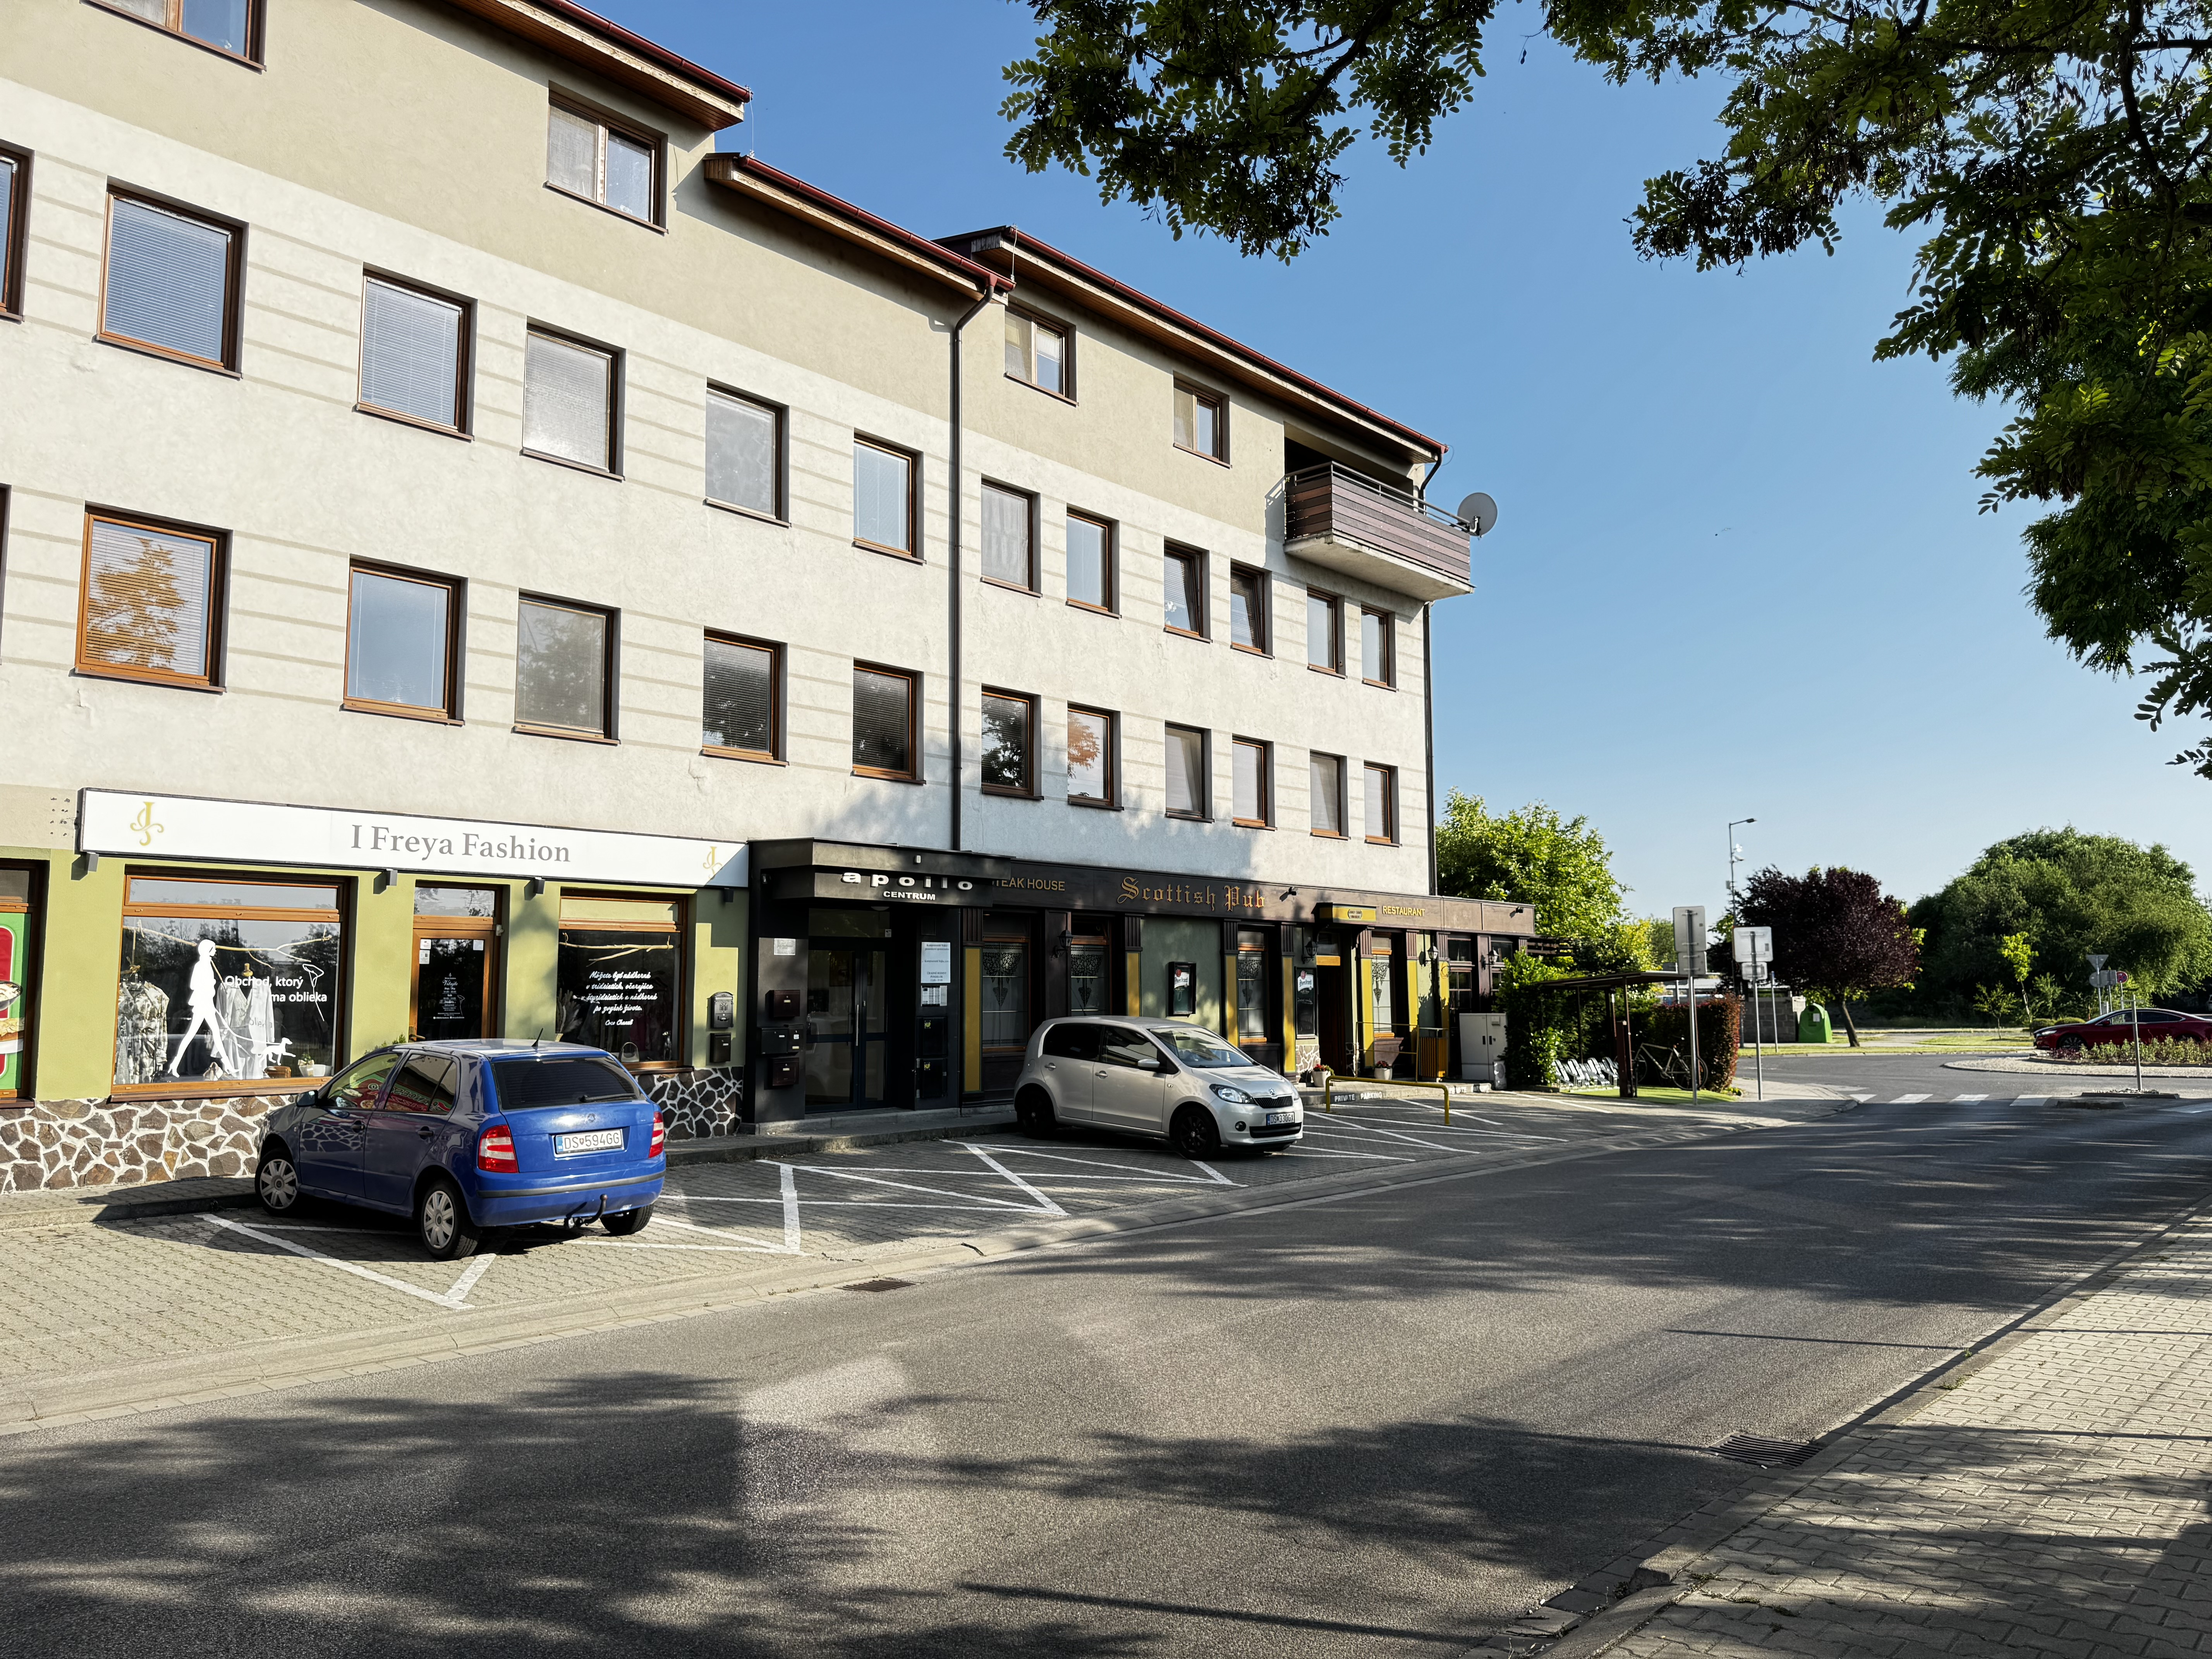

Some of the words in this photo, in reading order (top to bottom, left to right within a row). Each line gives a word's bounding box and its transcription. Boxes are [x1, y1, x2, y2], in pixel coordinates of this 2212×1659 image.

[350, 824, 362, 848] I
[370, 826, 454, 860] Freya
[462, 833, 571, 862] Fashion
[842, 871, 973, 890] apollo
[1027, 879, 1065, 891] HOUSE
[883, 891, 936, 900] CENTRUM
[1117, 877, 1216, 911] Scottish
[1224, 885, 1265, 912] Pub
[1382, 905, 1425, 916] RESTAURANT
[225, 975, 272, 988] Obchod,
[276, 976, 304, 989] ktorý
[289, 991, 327, 1002] oblieka
[564, 1137, 579, 1149] DS
[585, 1132, 619, 1147] 594GG
